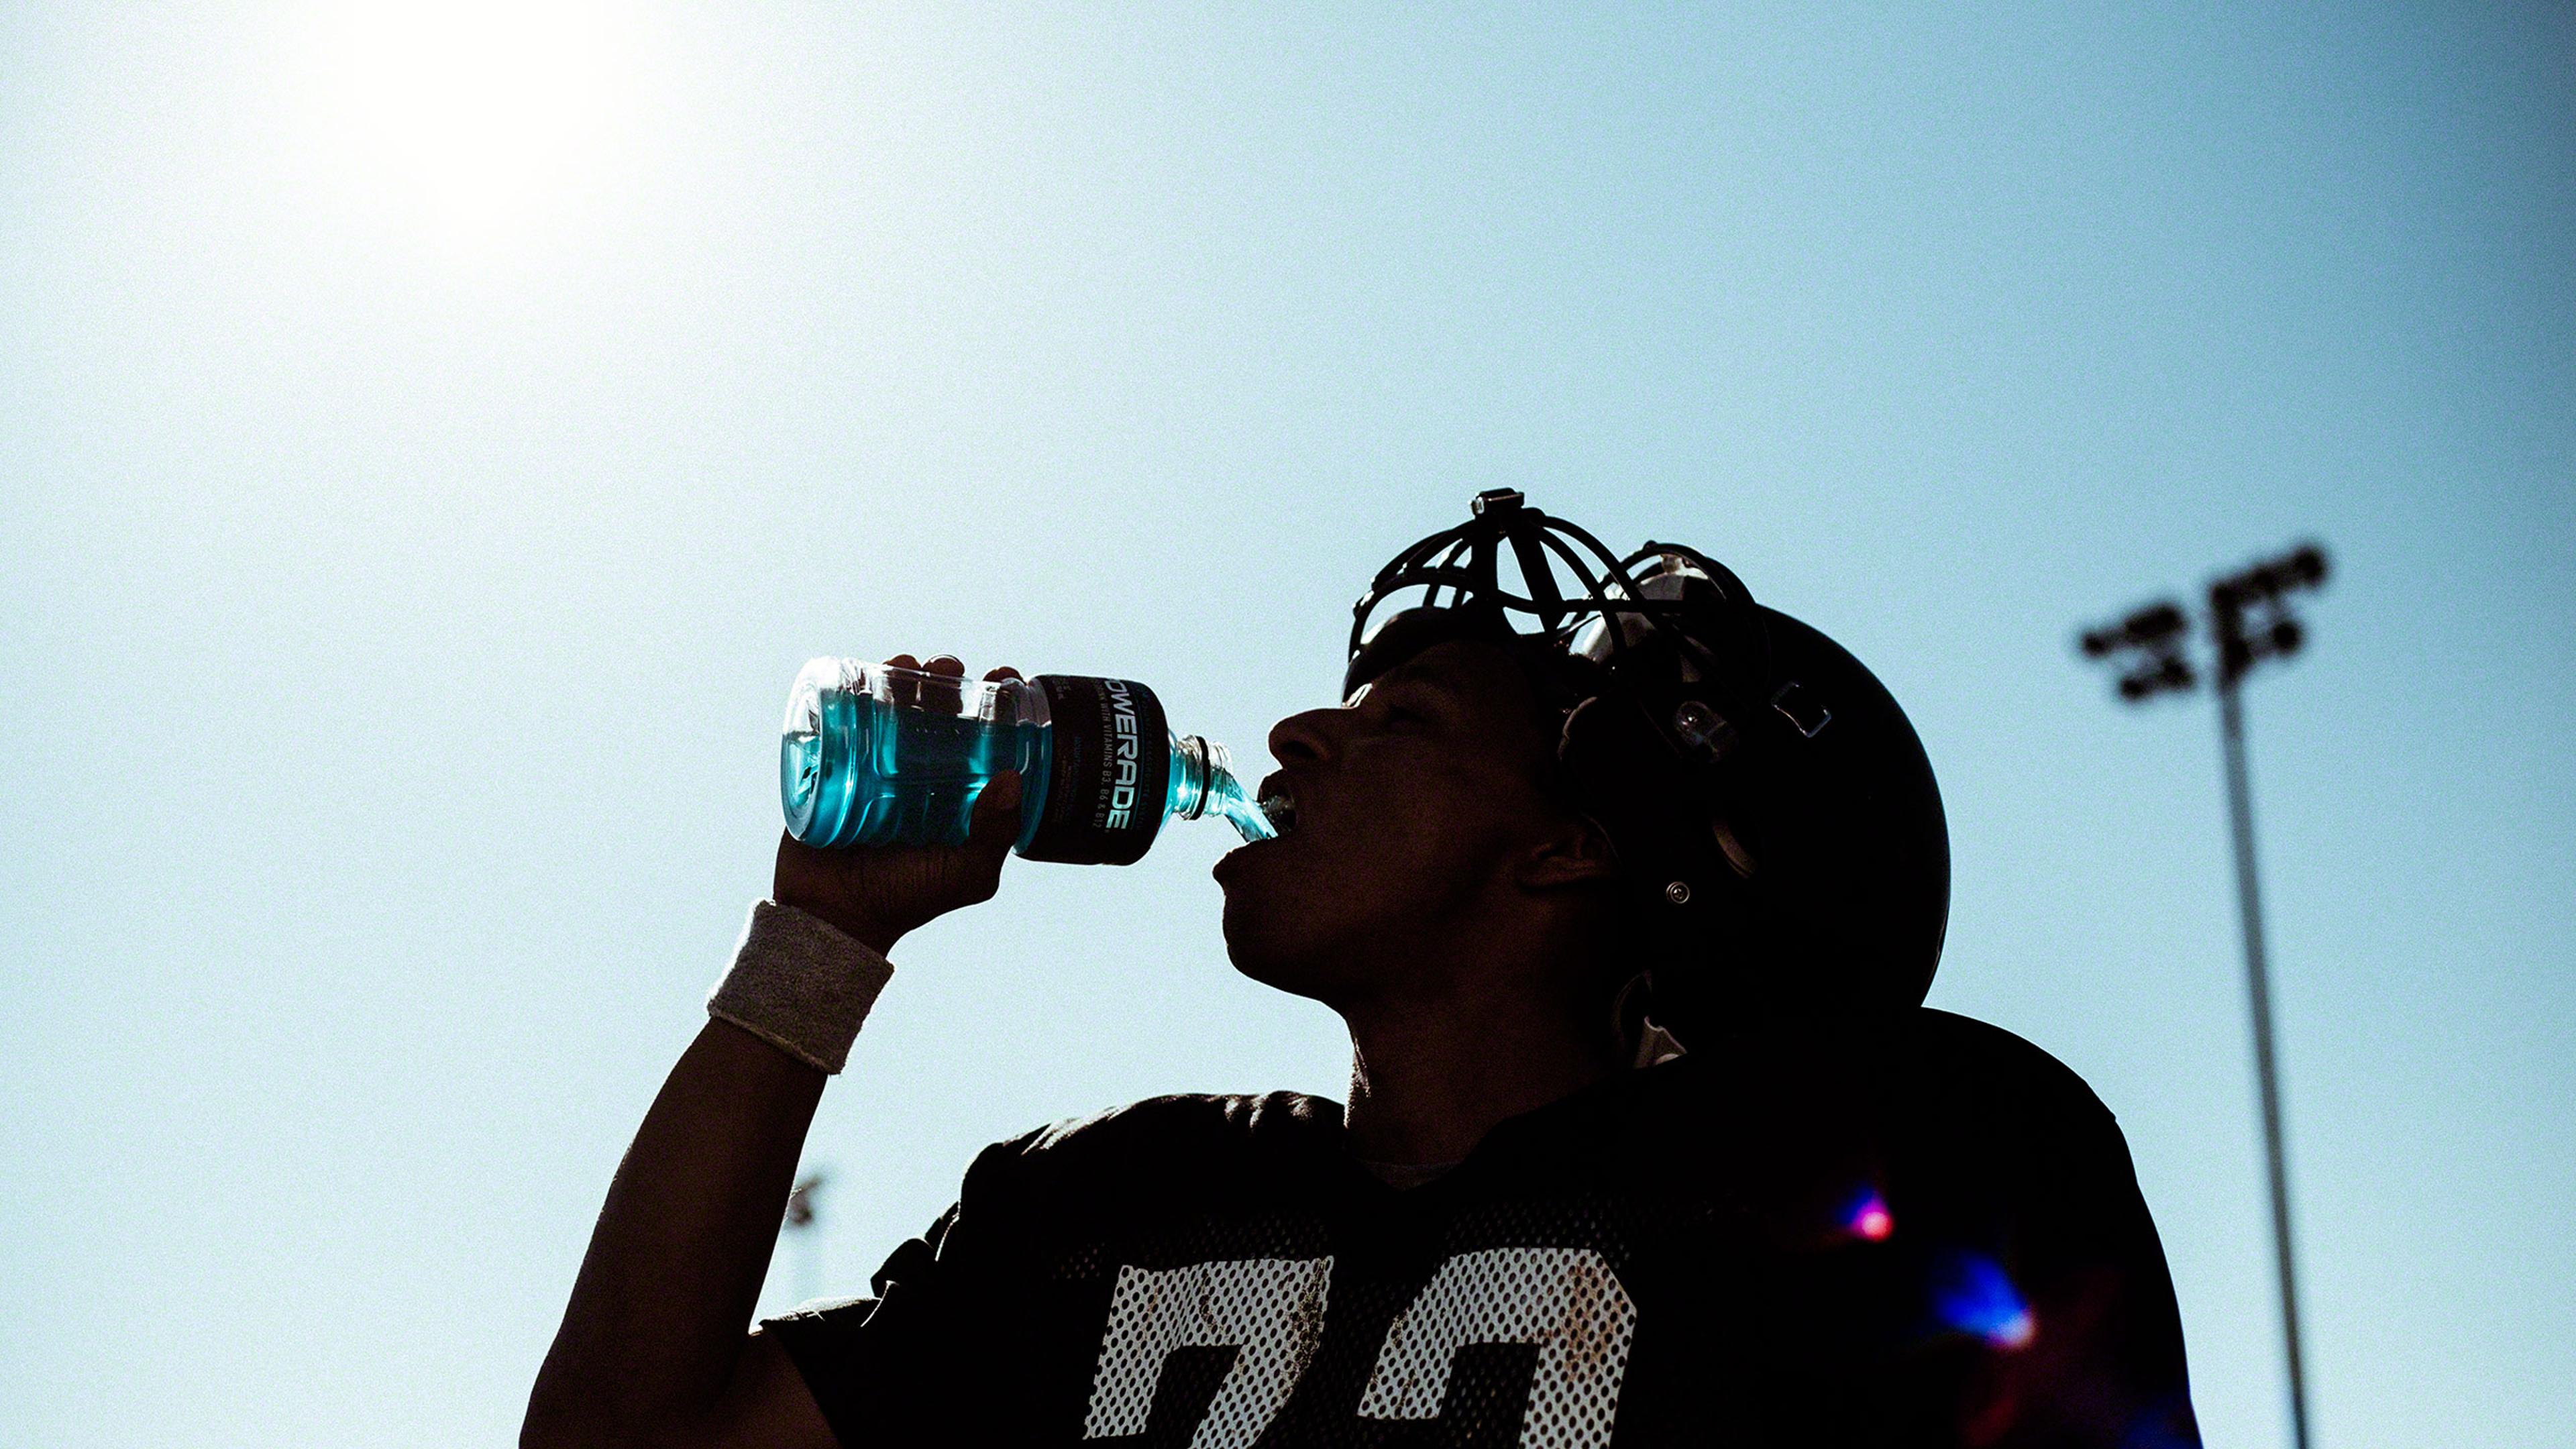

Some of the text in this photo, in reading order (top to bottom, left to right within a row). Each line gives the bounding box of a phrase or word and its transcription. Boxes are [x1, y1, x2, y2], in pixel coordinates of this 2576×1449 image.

[1100, 702, 1111, 722] WITH
[1103, 724, 1113, 768] VITAMINS
[1104, 679, 1138, 830] OWERADE
[1099, 788, 1110, 800] B6
[1092, 812, 1105, 828] B12
